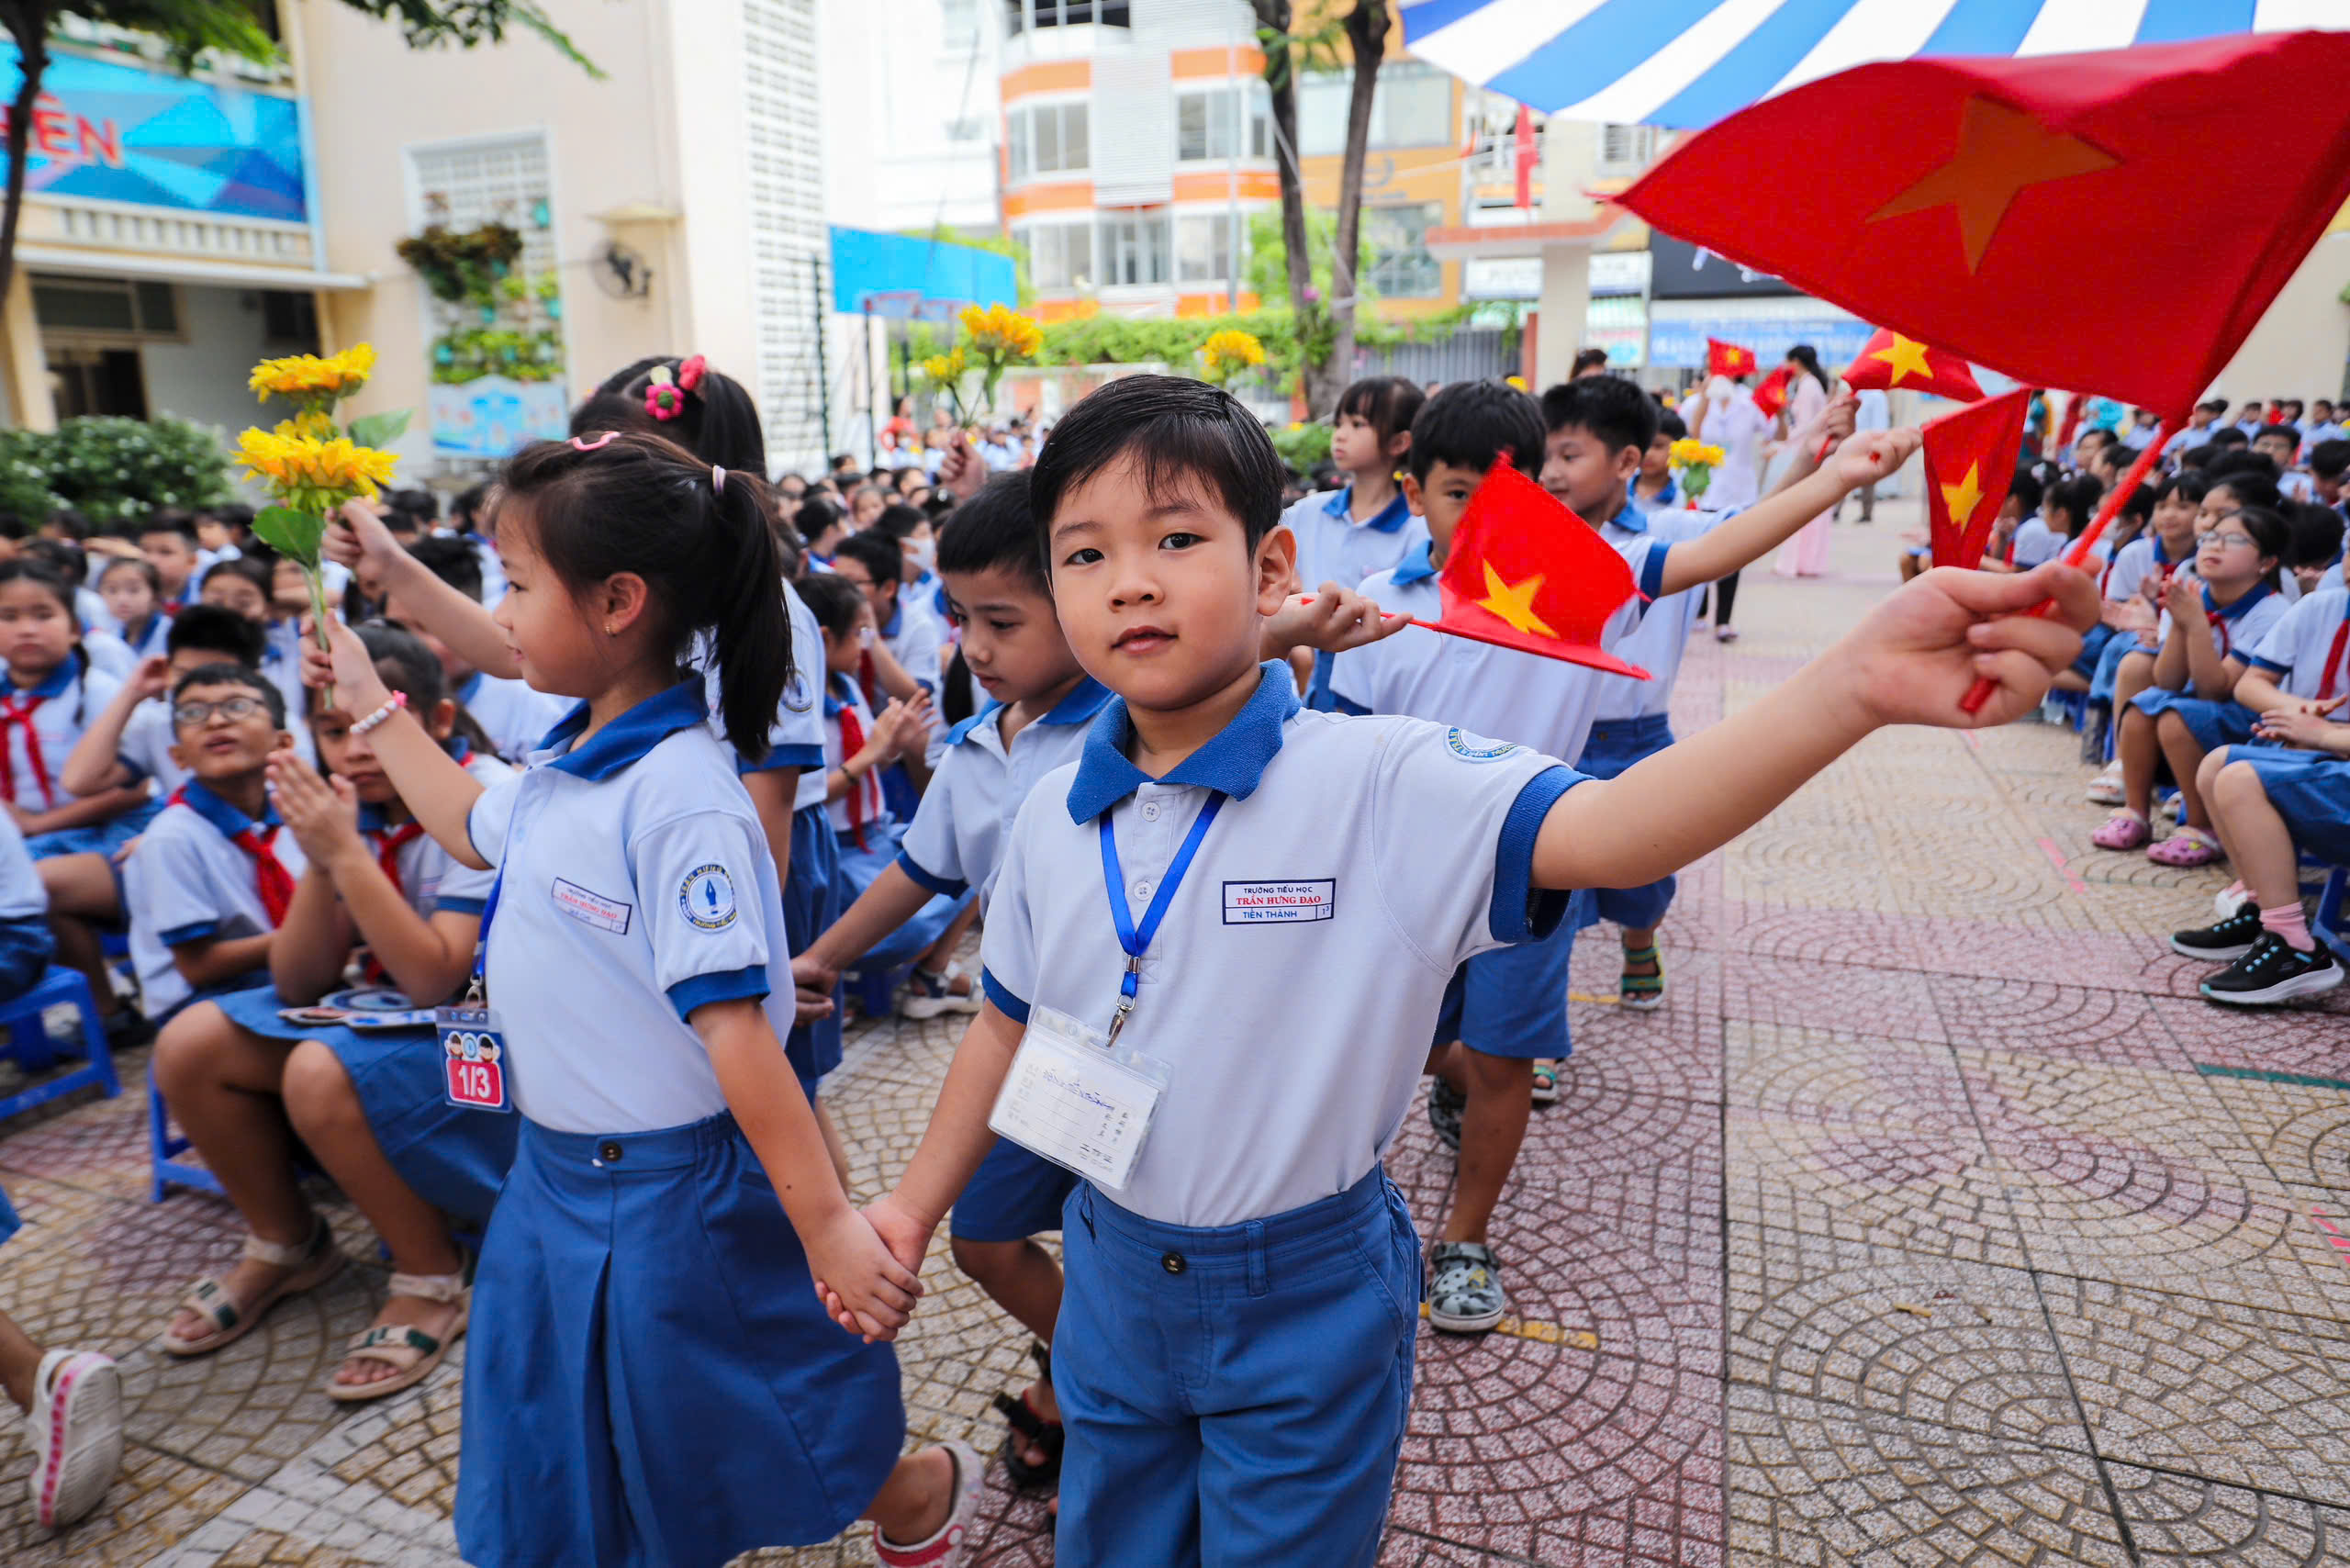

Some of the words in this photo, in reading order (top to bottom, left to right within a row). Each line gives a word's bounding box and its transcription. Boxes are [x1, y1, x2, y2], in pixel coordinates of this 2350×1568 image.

[1277, 885, 1293, 893] TIỂU
[1296, 886, 1313, 894] HỌC
[1237, 894, 1264, 905] TRẦN
[1267, 896, 1296, 905] HƯNG
[1299, 895, 1322, 905] ĐẠO
[459, 1065, 492, 1099] 1/3
